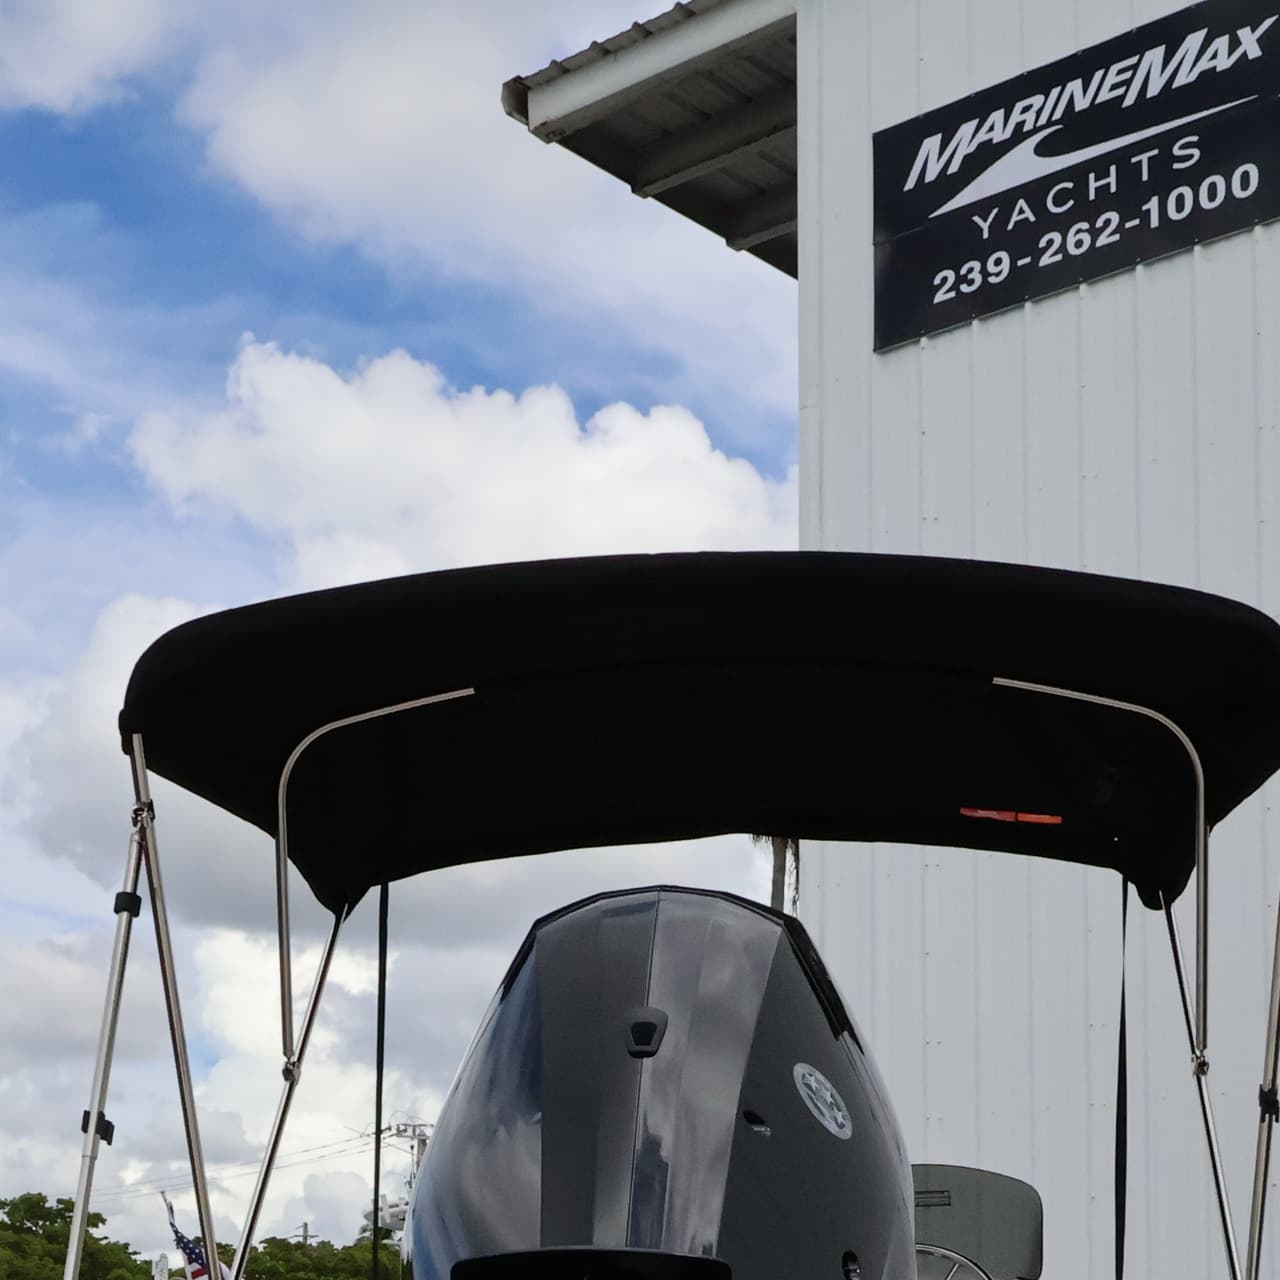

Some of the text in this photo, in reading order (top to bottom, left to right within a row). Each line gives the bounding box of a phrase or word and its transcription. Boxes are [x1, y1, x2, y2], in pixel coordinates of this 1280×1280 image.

[903, 15, 1279, 192] MARINEMAX
[933, 162, 1260, 304] 239-262-1000
[973, 136, 1201, 240] YACHTS
